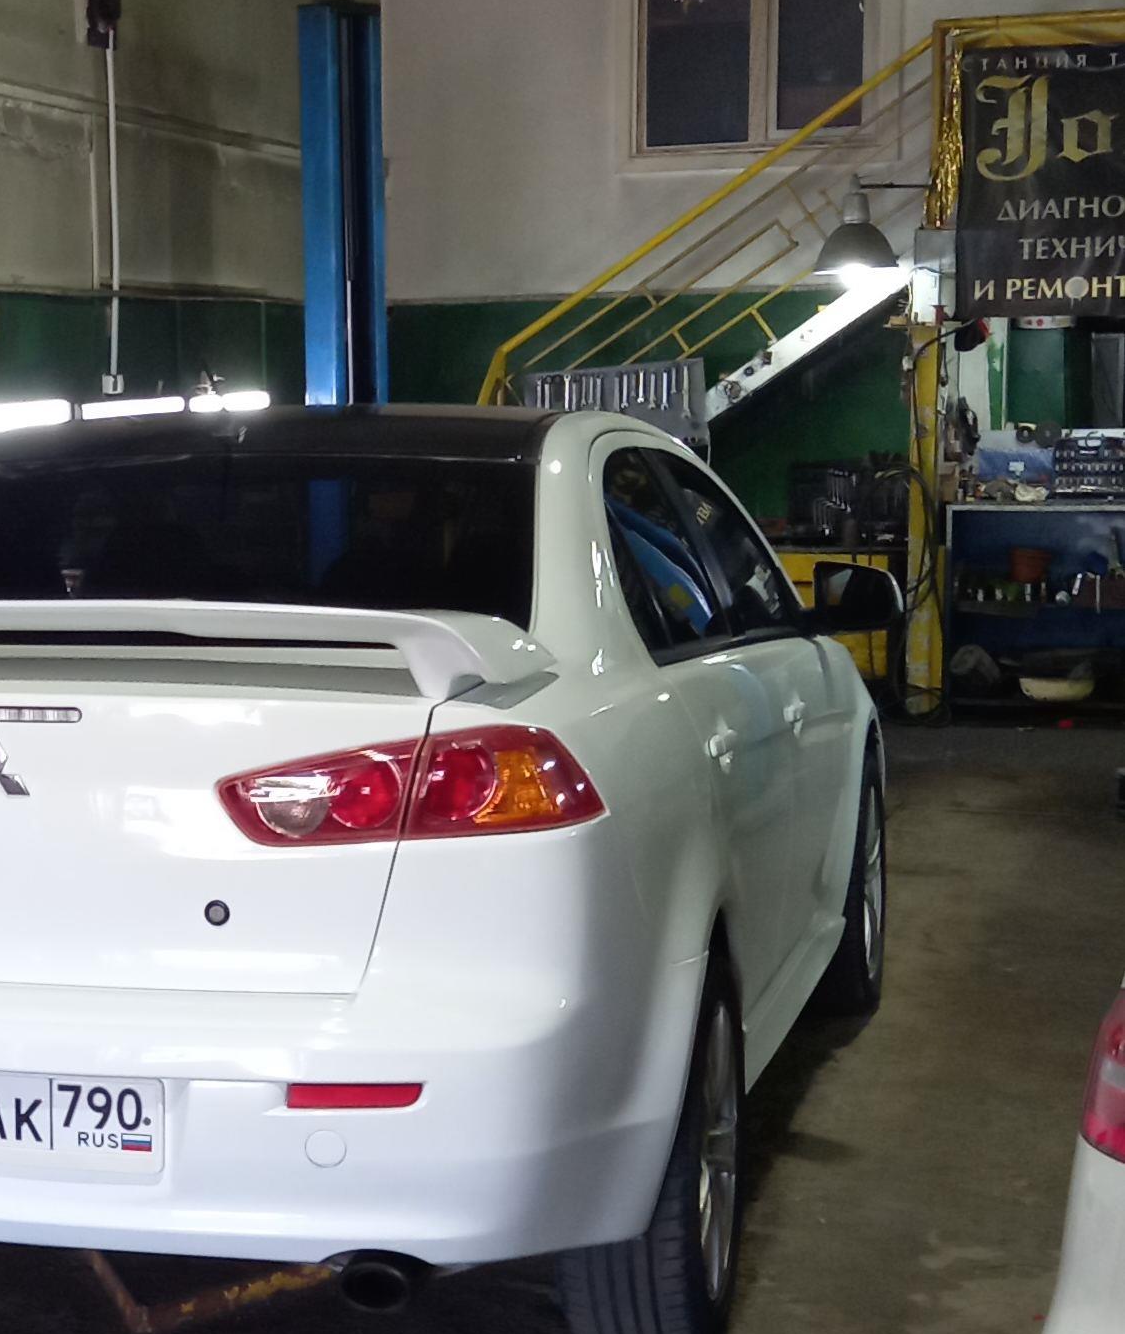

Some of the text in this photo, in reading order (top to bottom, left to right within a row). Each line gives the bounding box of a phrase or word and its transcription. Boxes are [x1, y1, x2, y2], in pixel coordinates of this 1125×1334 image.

[997, 196, 1125, 221] ДИАГНО
[974, 280, 995, 301] И
[58, 1084, 142, 1130] 790
[77, 1132, 119, 1149] RUS
